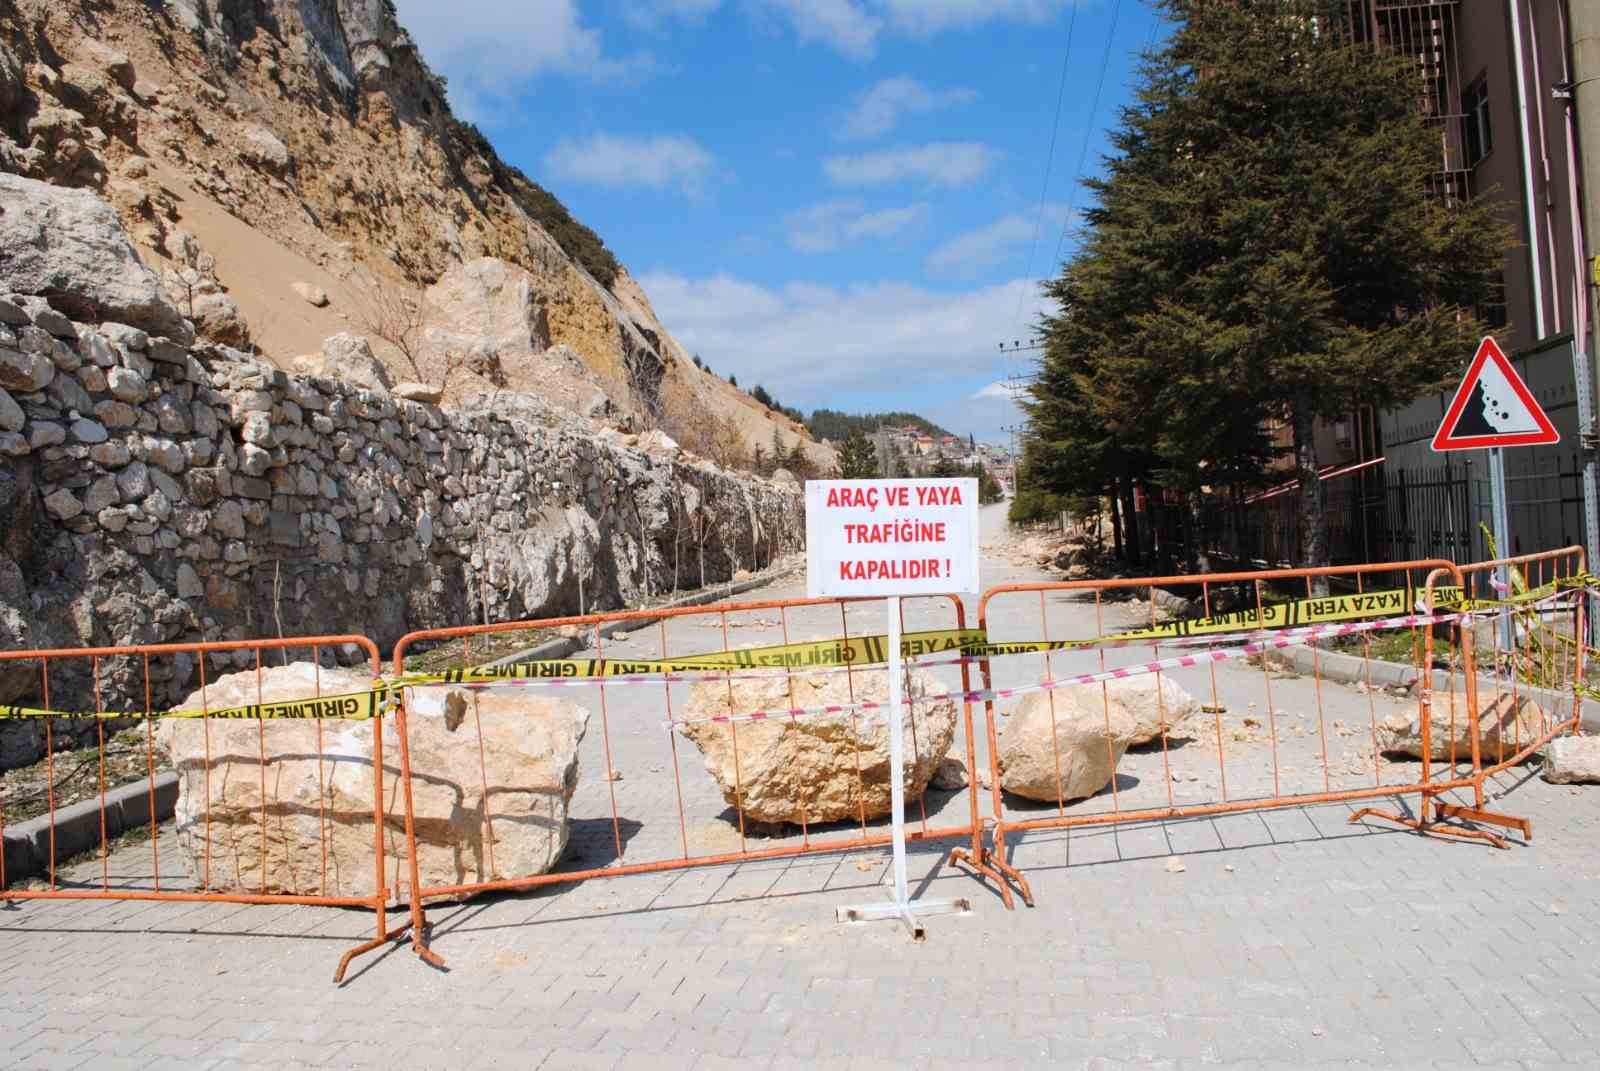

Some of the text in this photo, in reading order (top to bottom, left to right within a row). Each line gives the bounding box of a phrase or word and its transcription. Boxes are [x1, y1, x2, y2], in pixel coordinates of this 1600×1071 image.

[826, 486, 962, 512] ARAÇ VE YAYA
[844, 518, 946, 544] TRAFİĞİNE
[840, 559, 940, 580] KAPALIDIR
[1306, 598, 1349, 620] YERİ
[1352, 592, 1401, 612] KAZA
